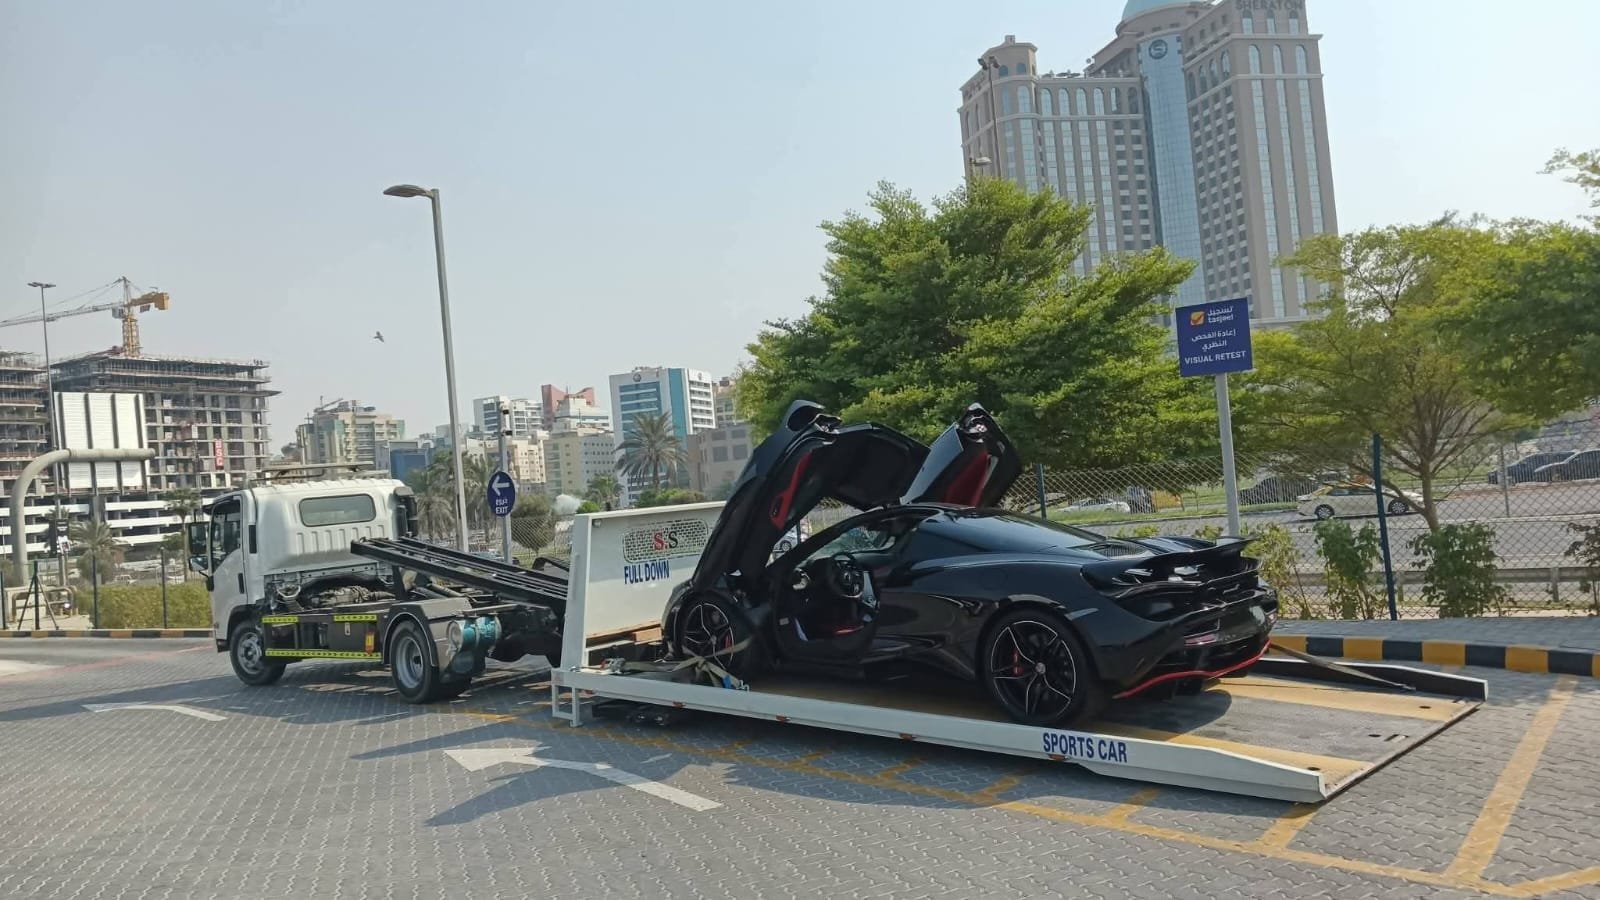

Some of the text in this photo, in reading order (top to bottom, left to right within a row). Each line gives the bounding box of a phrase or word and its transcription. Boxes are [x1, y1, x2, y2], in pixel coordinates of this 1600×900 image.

[1208, 306, 1233, 316] تسجيل
[1191, 332, 1216, 342] الفحص
[1202, 340, 1227, 352] النظري
[1184, 351, 1246, 364] VISUAL RETEST
[496, 506, 508, 514] EXIT
[624, 560, 670, 584] FULL DOWN
[1043, 732, 1128, 763] SPORTS CAR
